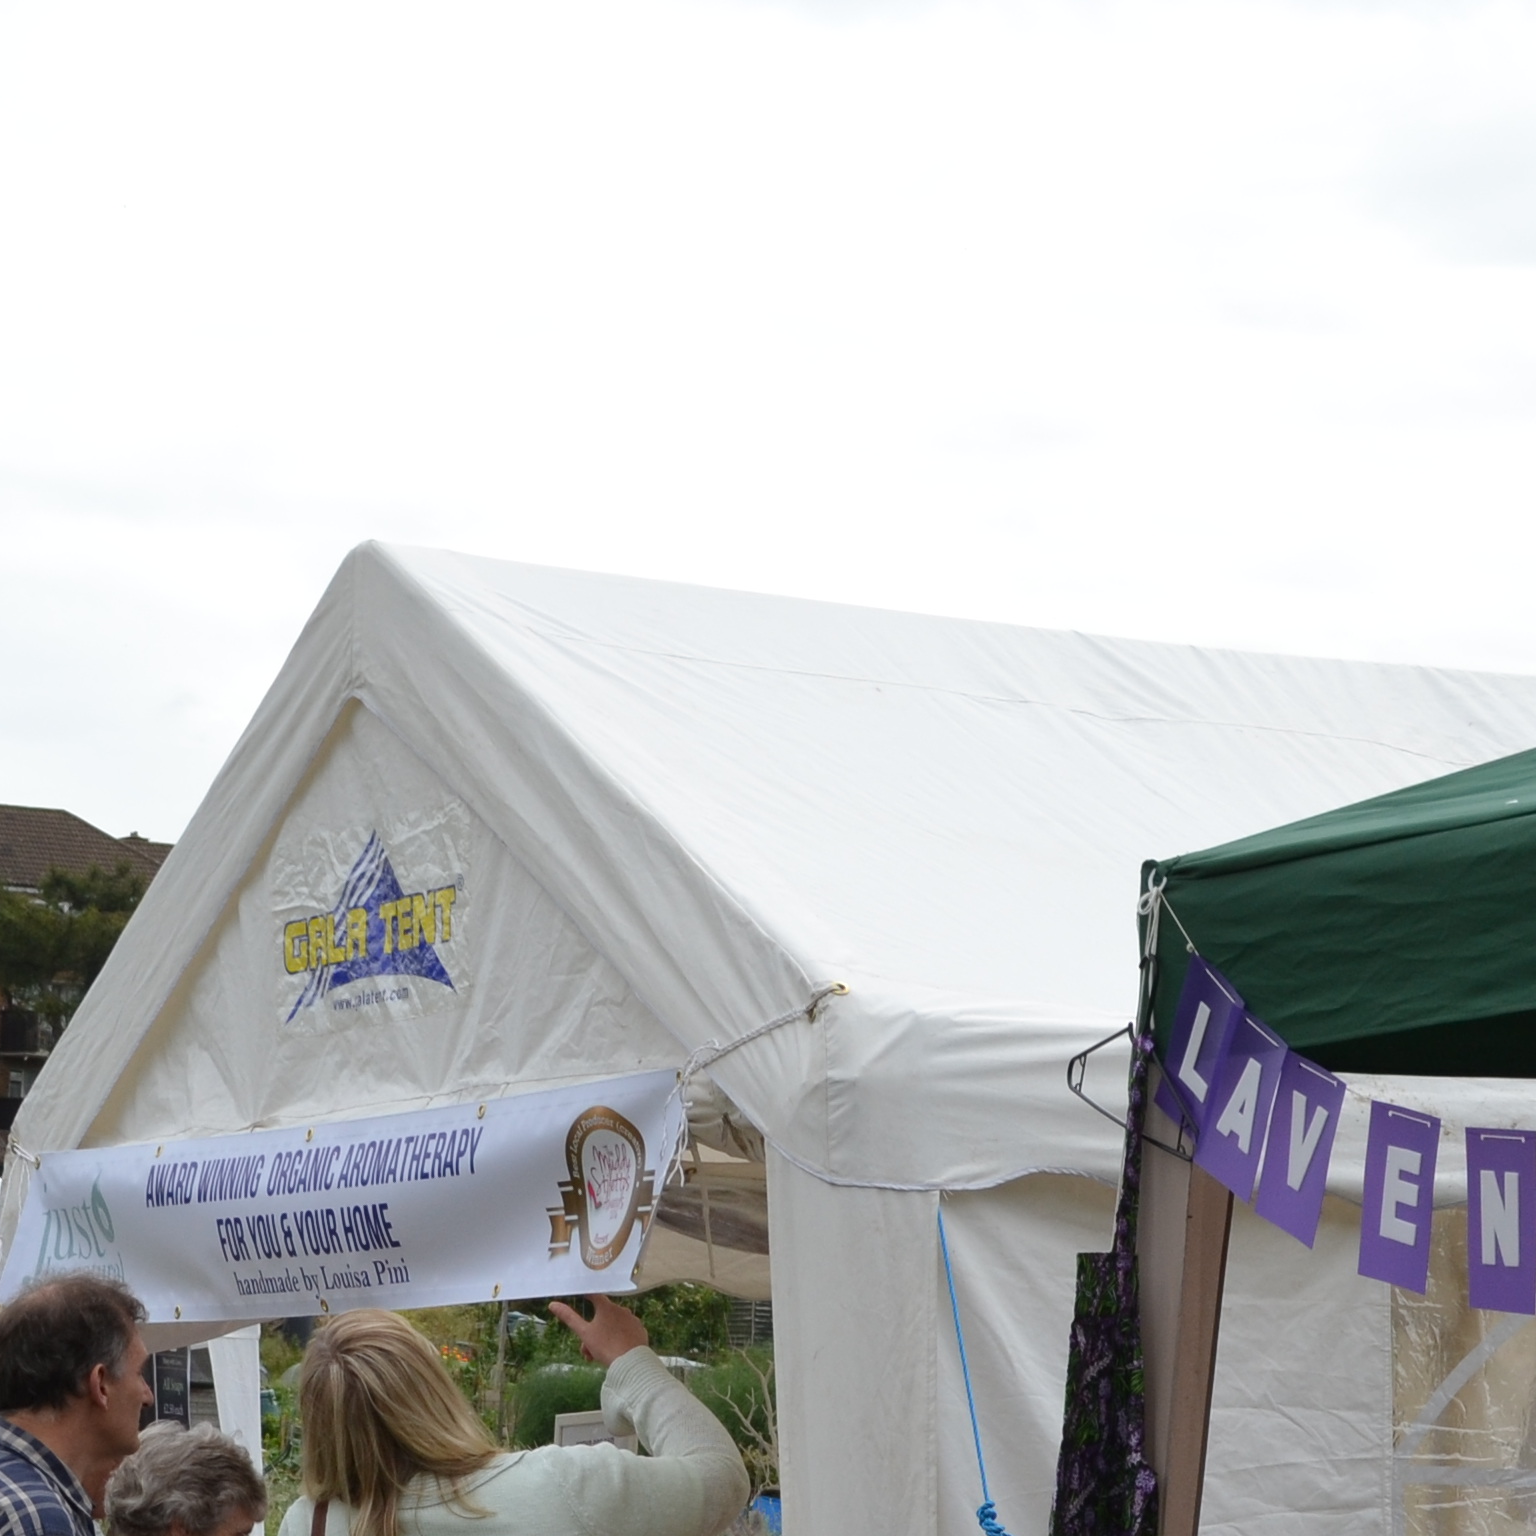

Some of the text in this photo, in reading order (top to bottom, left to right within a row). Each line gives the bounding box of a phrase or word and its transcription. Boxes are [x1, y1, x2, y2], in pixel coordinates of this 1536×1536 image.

[284, 884, 456, 974] GALA TENT
[146, 1126, 484, 1208] AWARD WINNING ORGANIC AROMATHERAPY
[23, 1183, 106, 1284] just
[217, 1203, 401, 1262] FOR YOU & YOUR HOME
[234, 1258, 411, 1299] handmade by Louisa Pini
